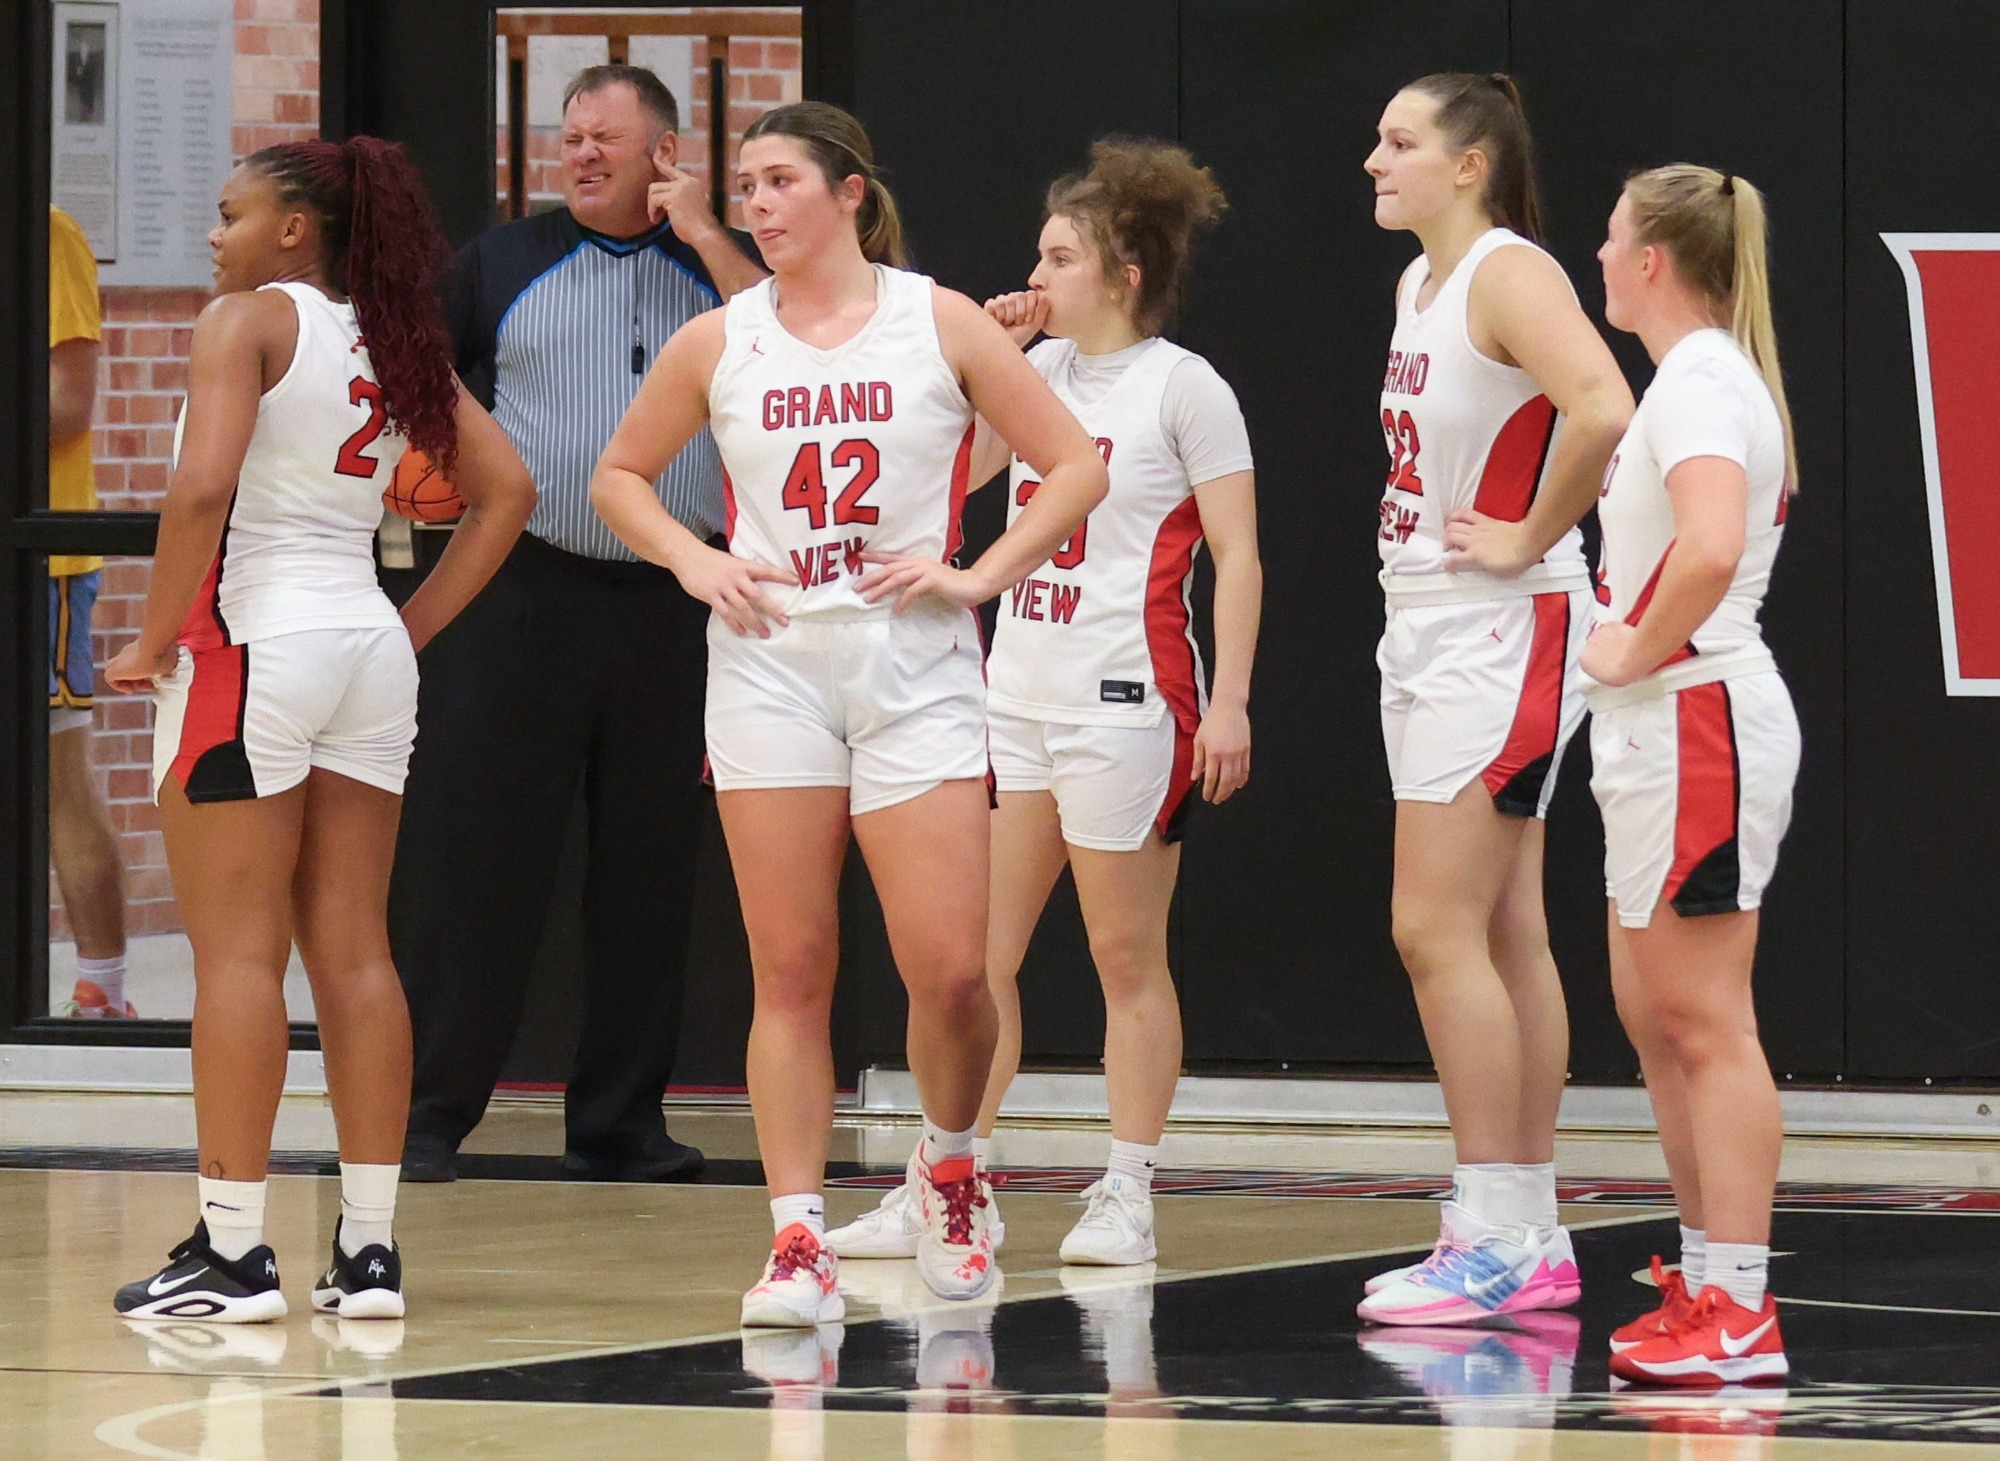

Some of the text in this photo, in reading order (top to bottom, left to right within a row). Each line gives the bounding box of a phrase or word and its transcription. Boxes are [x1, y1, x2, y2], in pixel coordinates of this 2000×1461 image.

[334, 375, 388, 478] 2
[762, 381, 893, 431] GRAND
[1383, 408, 1424, 497] 32
[782, 438, 880, 530] 42
[789, 536, 869, 591] VIEW
[1012, 579, 1081, 624] VIEW
[1131, 687, 1139, 697] M
